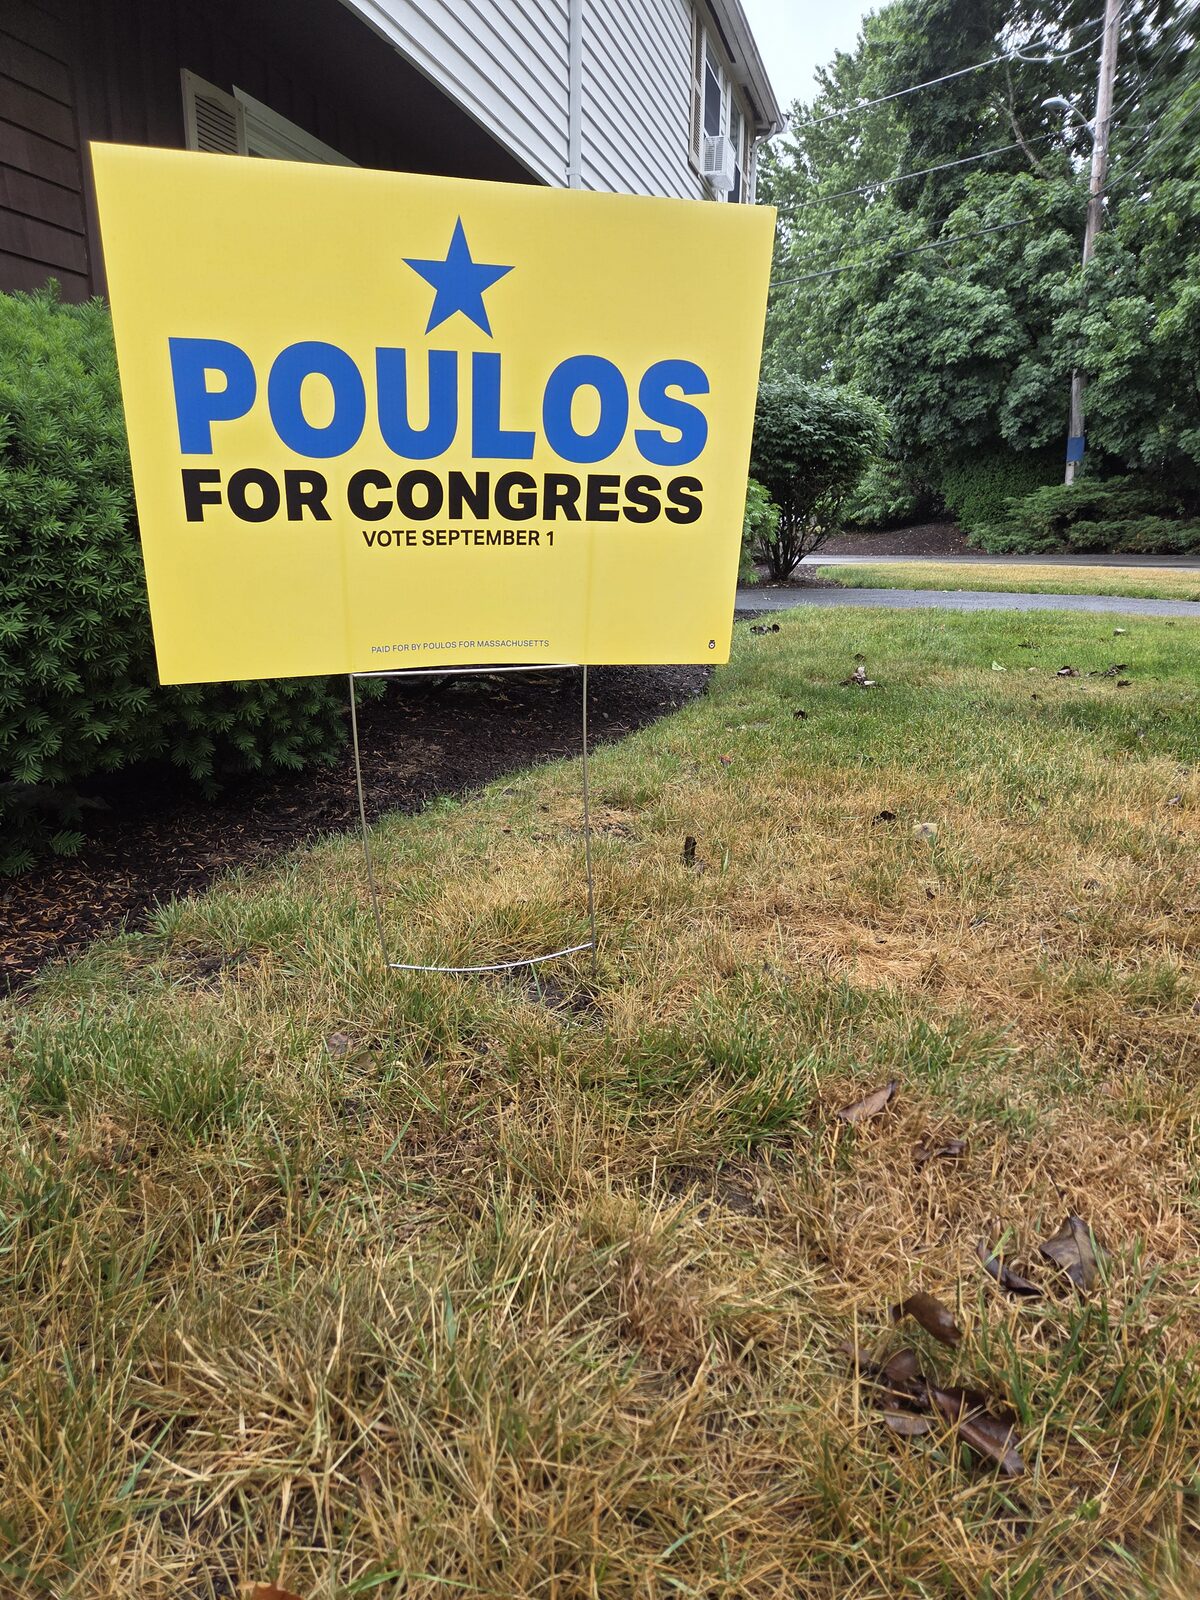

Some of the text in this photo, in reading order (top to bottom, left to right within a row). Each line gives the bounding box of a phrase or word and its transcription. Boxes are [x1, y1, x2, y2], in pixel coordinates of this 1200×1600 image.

[168, 337, 710, 467] POULOS
[181, 468, 704, 525] FOR CONGRESS
[362, 529, 554, 547] VOTE SEPTEMBER 1
[371, 639, 550, 653] PAID FOR BY POULOS FOR MASSACHUSETTS
